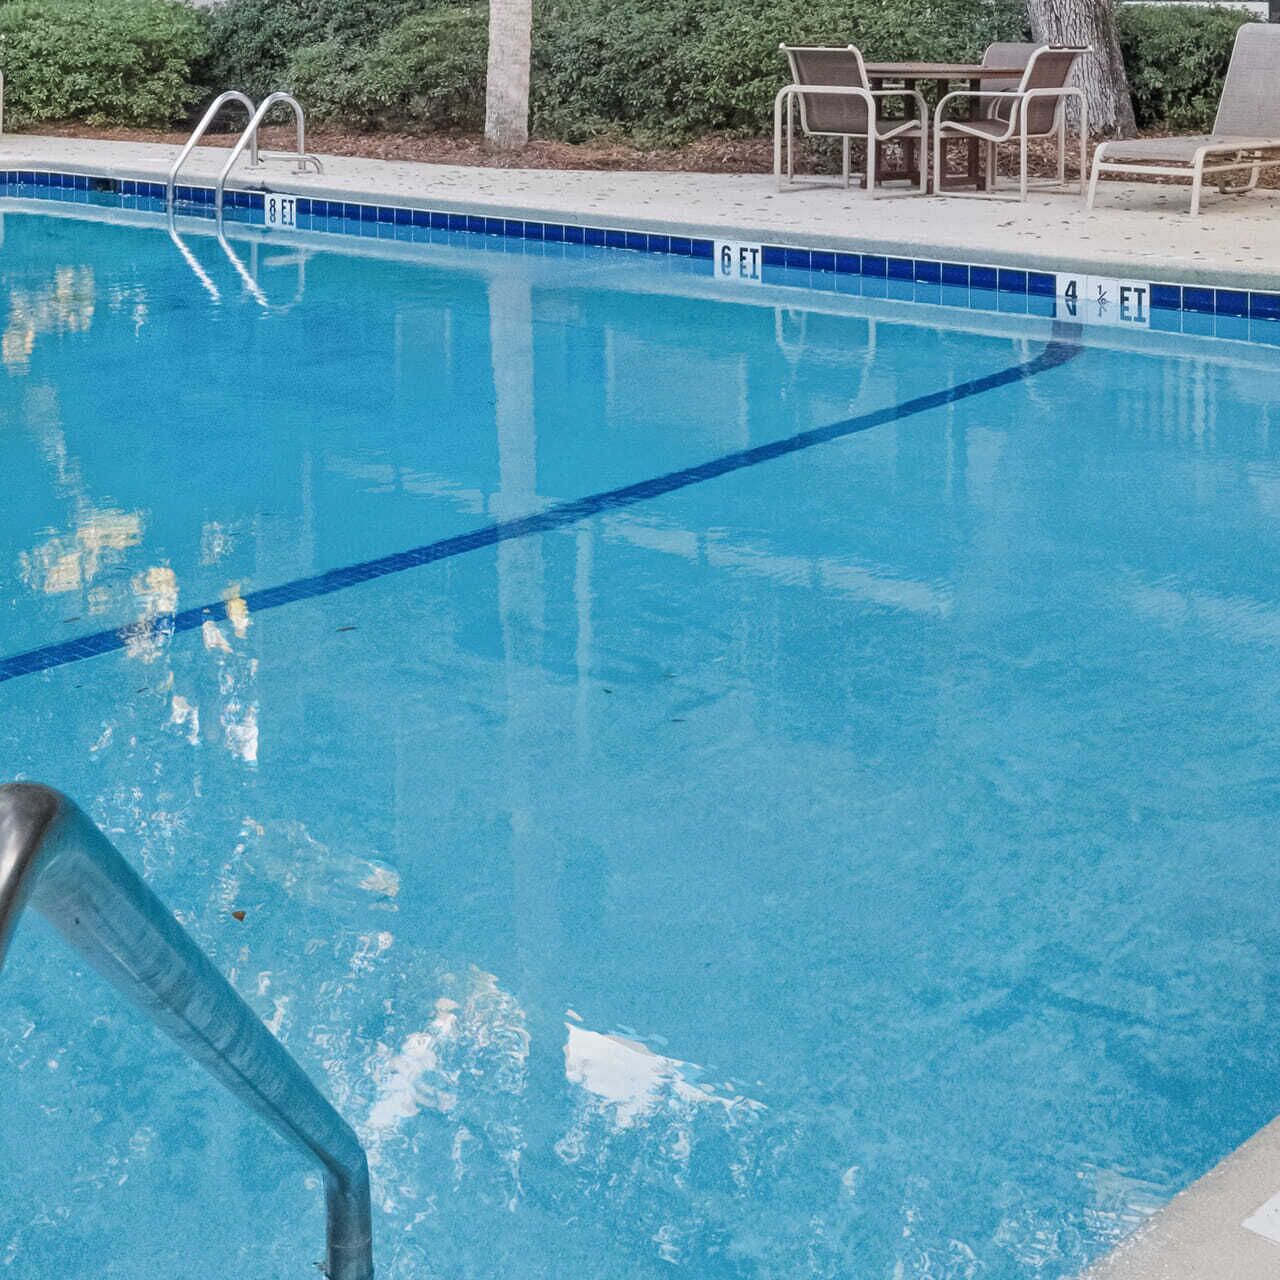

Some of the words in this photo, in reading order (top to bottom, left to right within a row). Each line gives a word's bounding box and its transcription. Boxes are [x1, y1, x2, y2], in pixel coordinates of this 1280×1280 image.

[269, 198, 276, 217] 8
[721, 245, 732, 267] 6
[1064, 280, 1078, 302] 4
